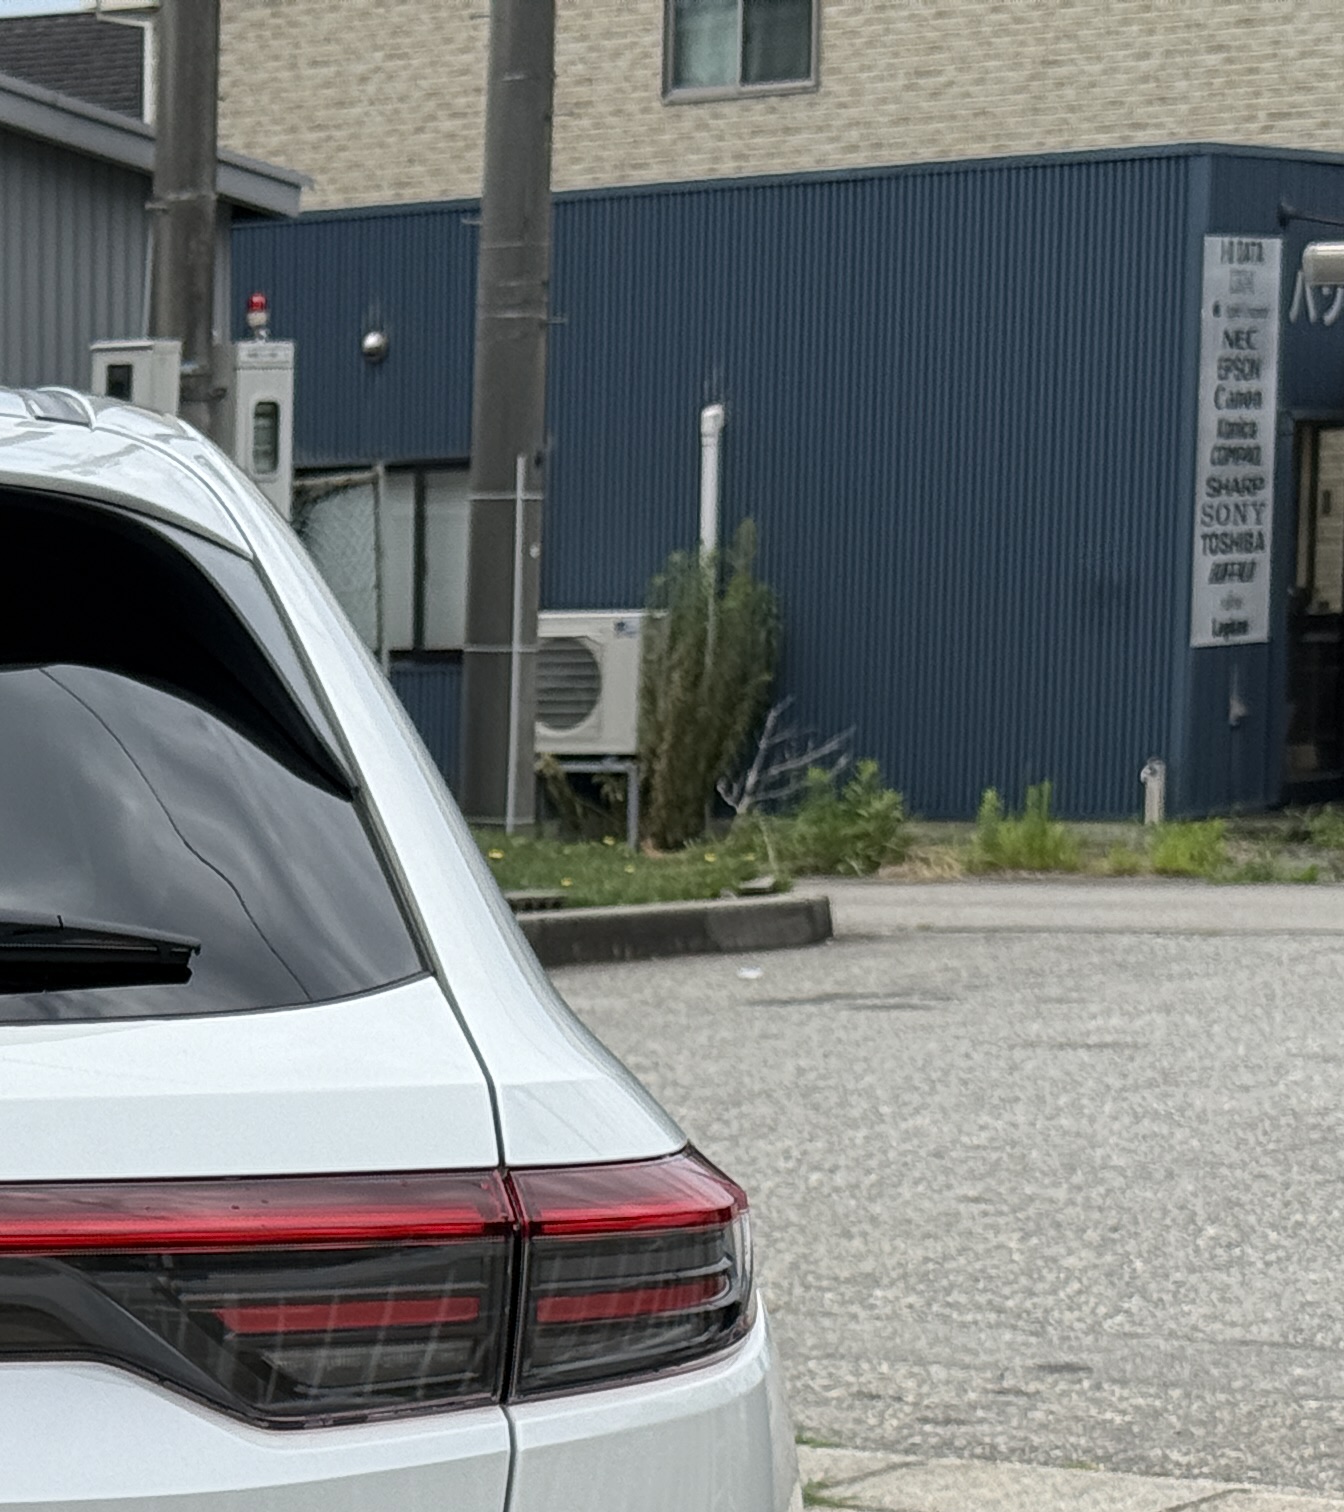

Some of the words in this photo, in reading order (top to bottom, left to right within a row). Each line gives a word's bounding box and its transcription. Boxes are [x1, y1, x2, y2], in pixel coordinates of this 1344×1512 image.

[1222, 328, 1258, 351] NEC
[1216, 356, 1262, 381] EPSON
[1213, 384, 1263, 410] Canon
[1205, 475, 1266, 498] SHARP
[1200, 501, 1266, 527] SONY
[1200, 531, 1265, 556] TOSHIBA
